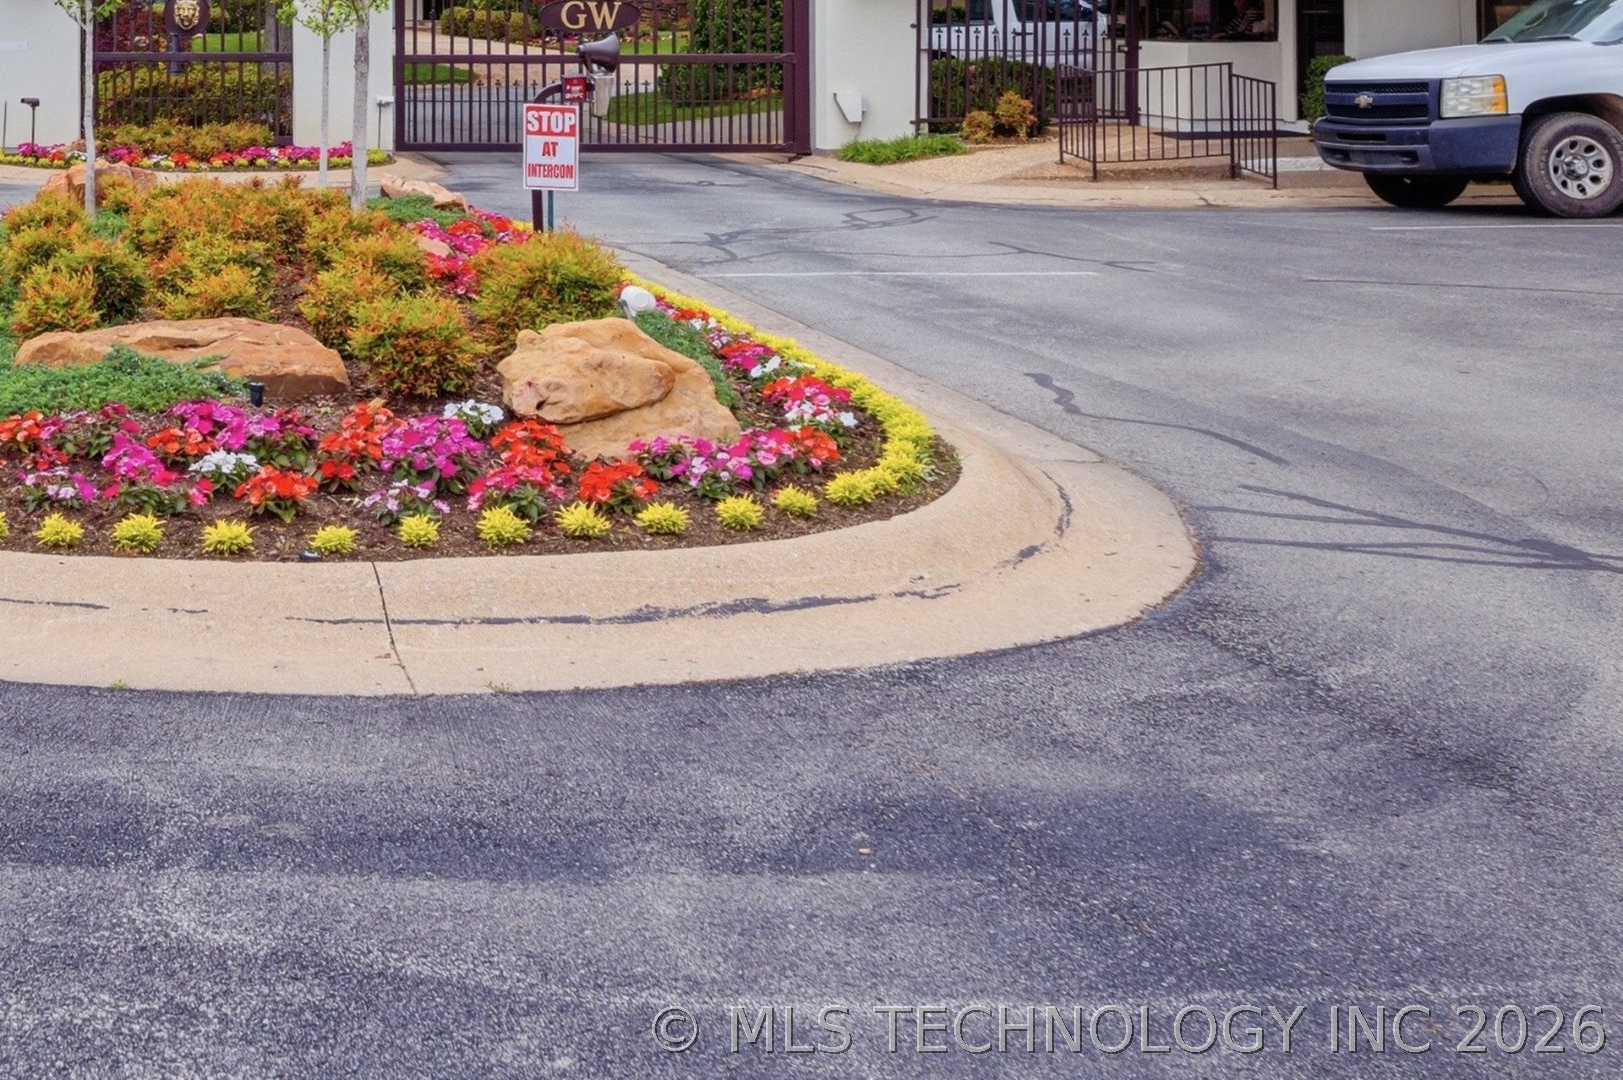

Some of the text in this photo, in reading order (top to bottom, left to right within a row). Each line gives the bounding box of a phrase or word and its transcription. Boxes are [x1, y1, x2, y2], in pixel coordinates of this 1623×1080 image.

[560, 0, 622, 30] GW
[527, 110, 575, 133] STOP
[541, 141, 558, 157] AT
[527, 163, 573, 179] INTERCOM
